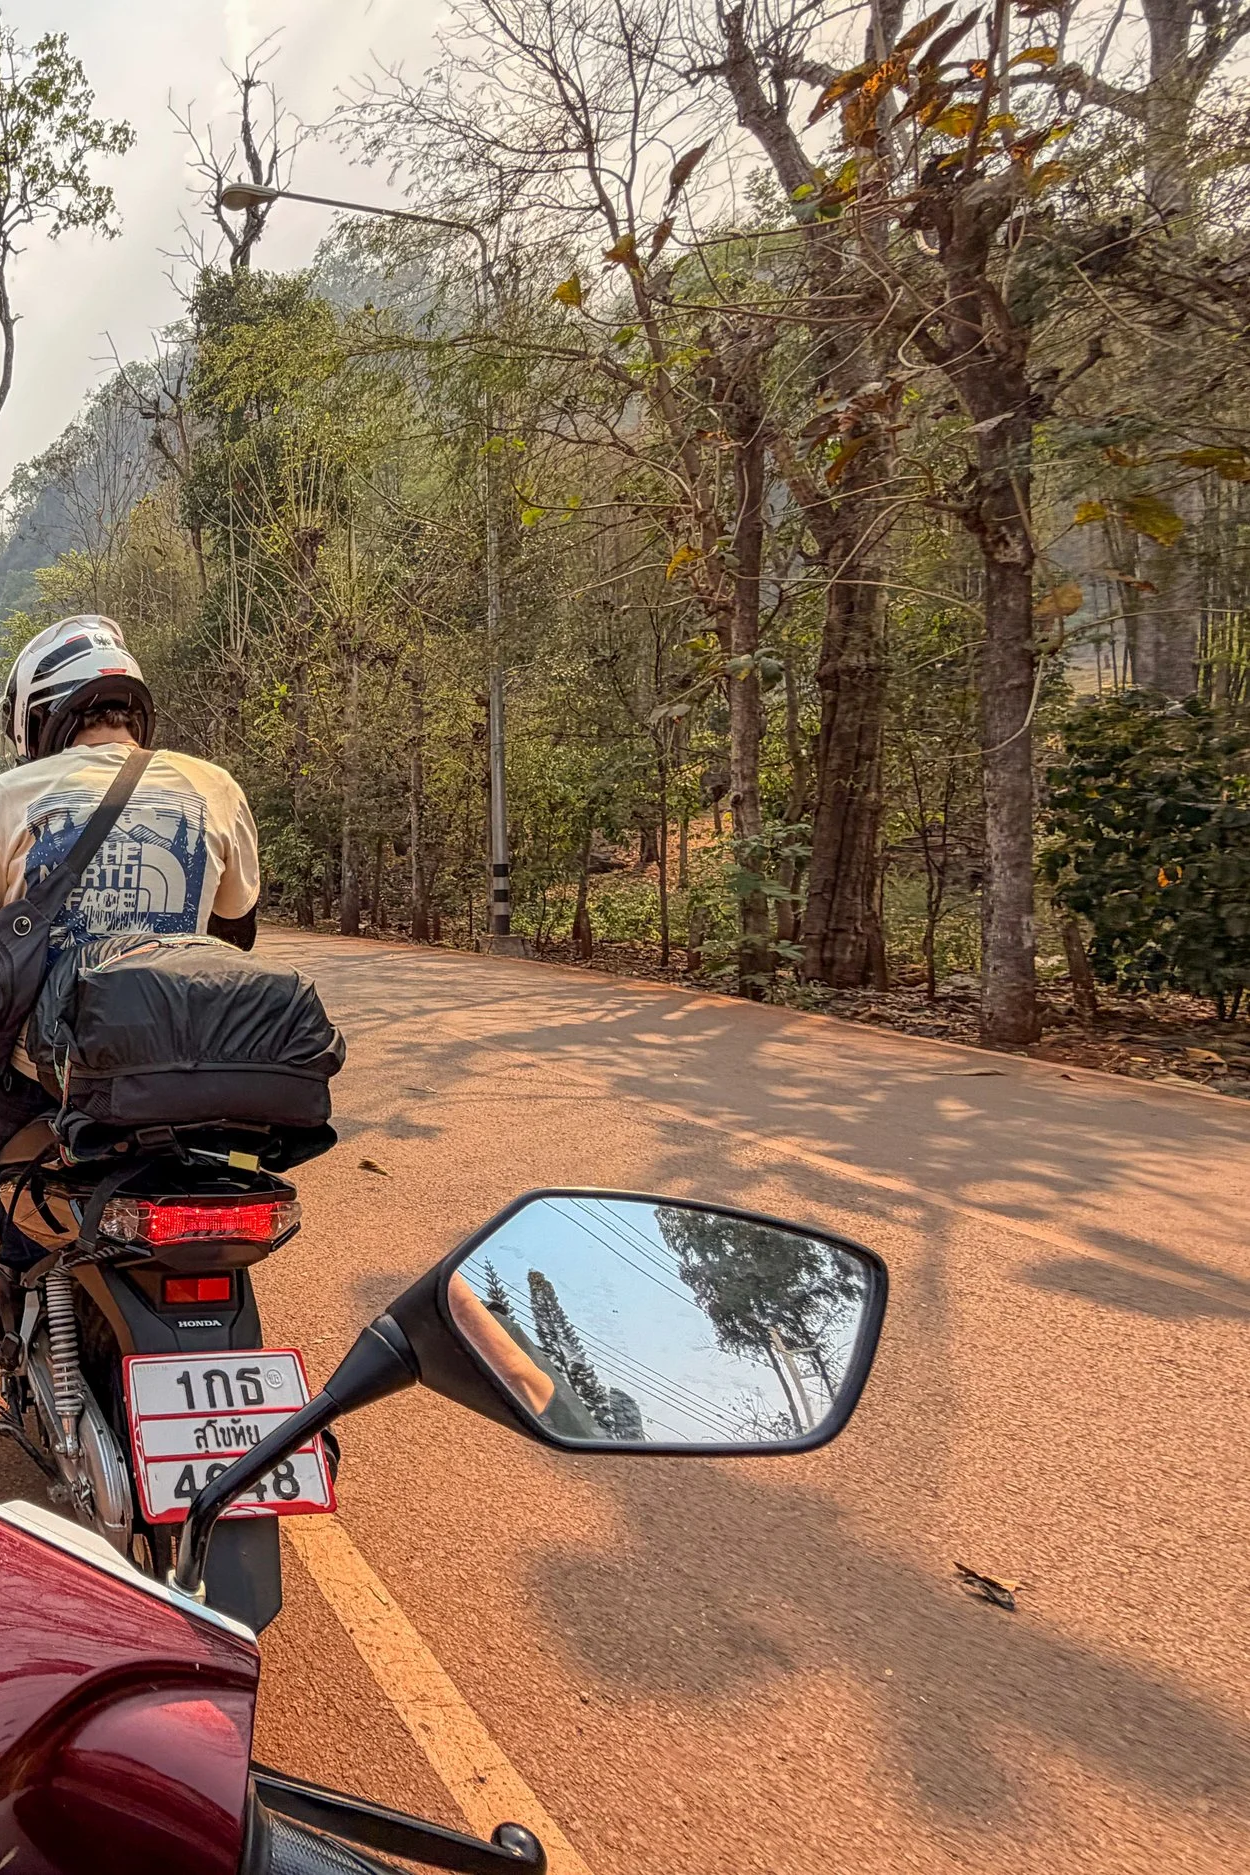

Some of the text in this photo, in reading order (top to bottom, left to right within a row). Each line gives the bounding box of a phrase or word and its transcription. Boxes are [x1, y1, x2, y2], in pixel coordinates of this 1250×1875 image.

[90, 841, 141, 864] HE
[64, 887, 137, 912] FACE
[177, 1319, 223, 1328] HONDA
[177, 1366, 265, 1410] 1กธ
[193, 1417, 262, 1454] สุโขทัย
